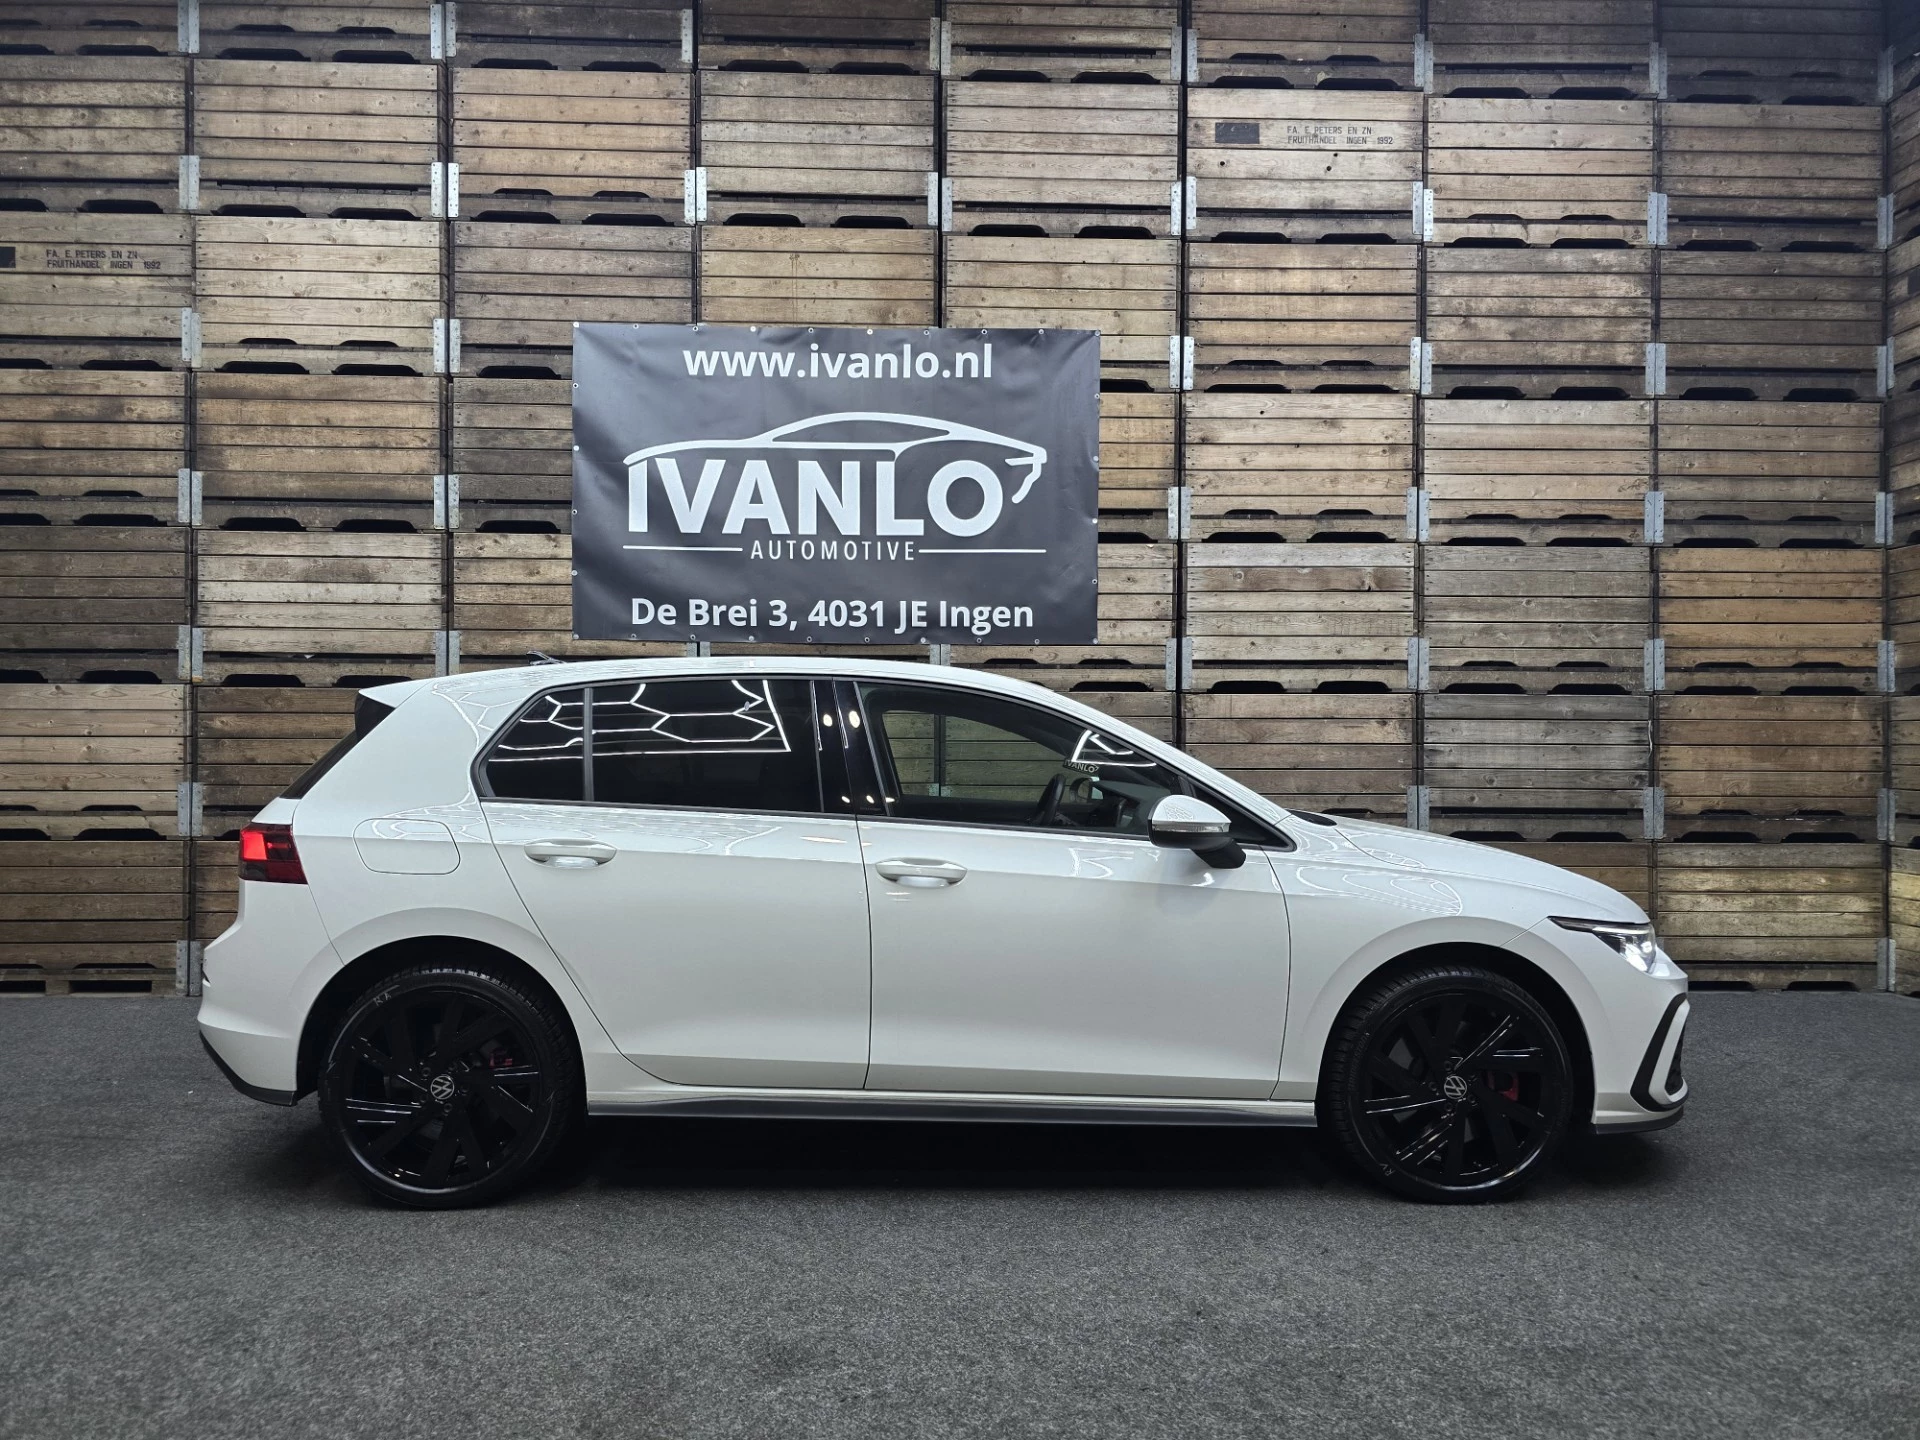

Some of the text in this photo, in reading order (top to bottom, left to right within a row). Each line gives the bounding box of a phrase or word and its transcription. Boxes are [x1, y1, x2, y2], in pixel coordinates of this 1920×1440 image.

[1287, 126, 1300, 134] FA.
[1314, 126, 1342, 135] PETERS
[1347, 126, 1358, 135] EN
[1361, 126, 1372, 135] ZN
[1287, 135, 1393, 145] FRUITHANDEL INGEN 1992
[46, 249, 59, 258] FA.
[75, 250, 106, 259] PETERS
[111, 250, 122, 259] EN
[47, 259, 161, 270] FRUITHANDEL INGEN 1992
[683, 343, 992, 380] www.ivanlo.nl
[628, 457, 1004, 537] IVANLO
[750, 539, 915, 561] AUTOMOTIVE
[631, 598, 1034, 636] De Brei 3, 4031 JE Ingen
